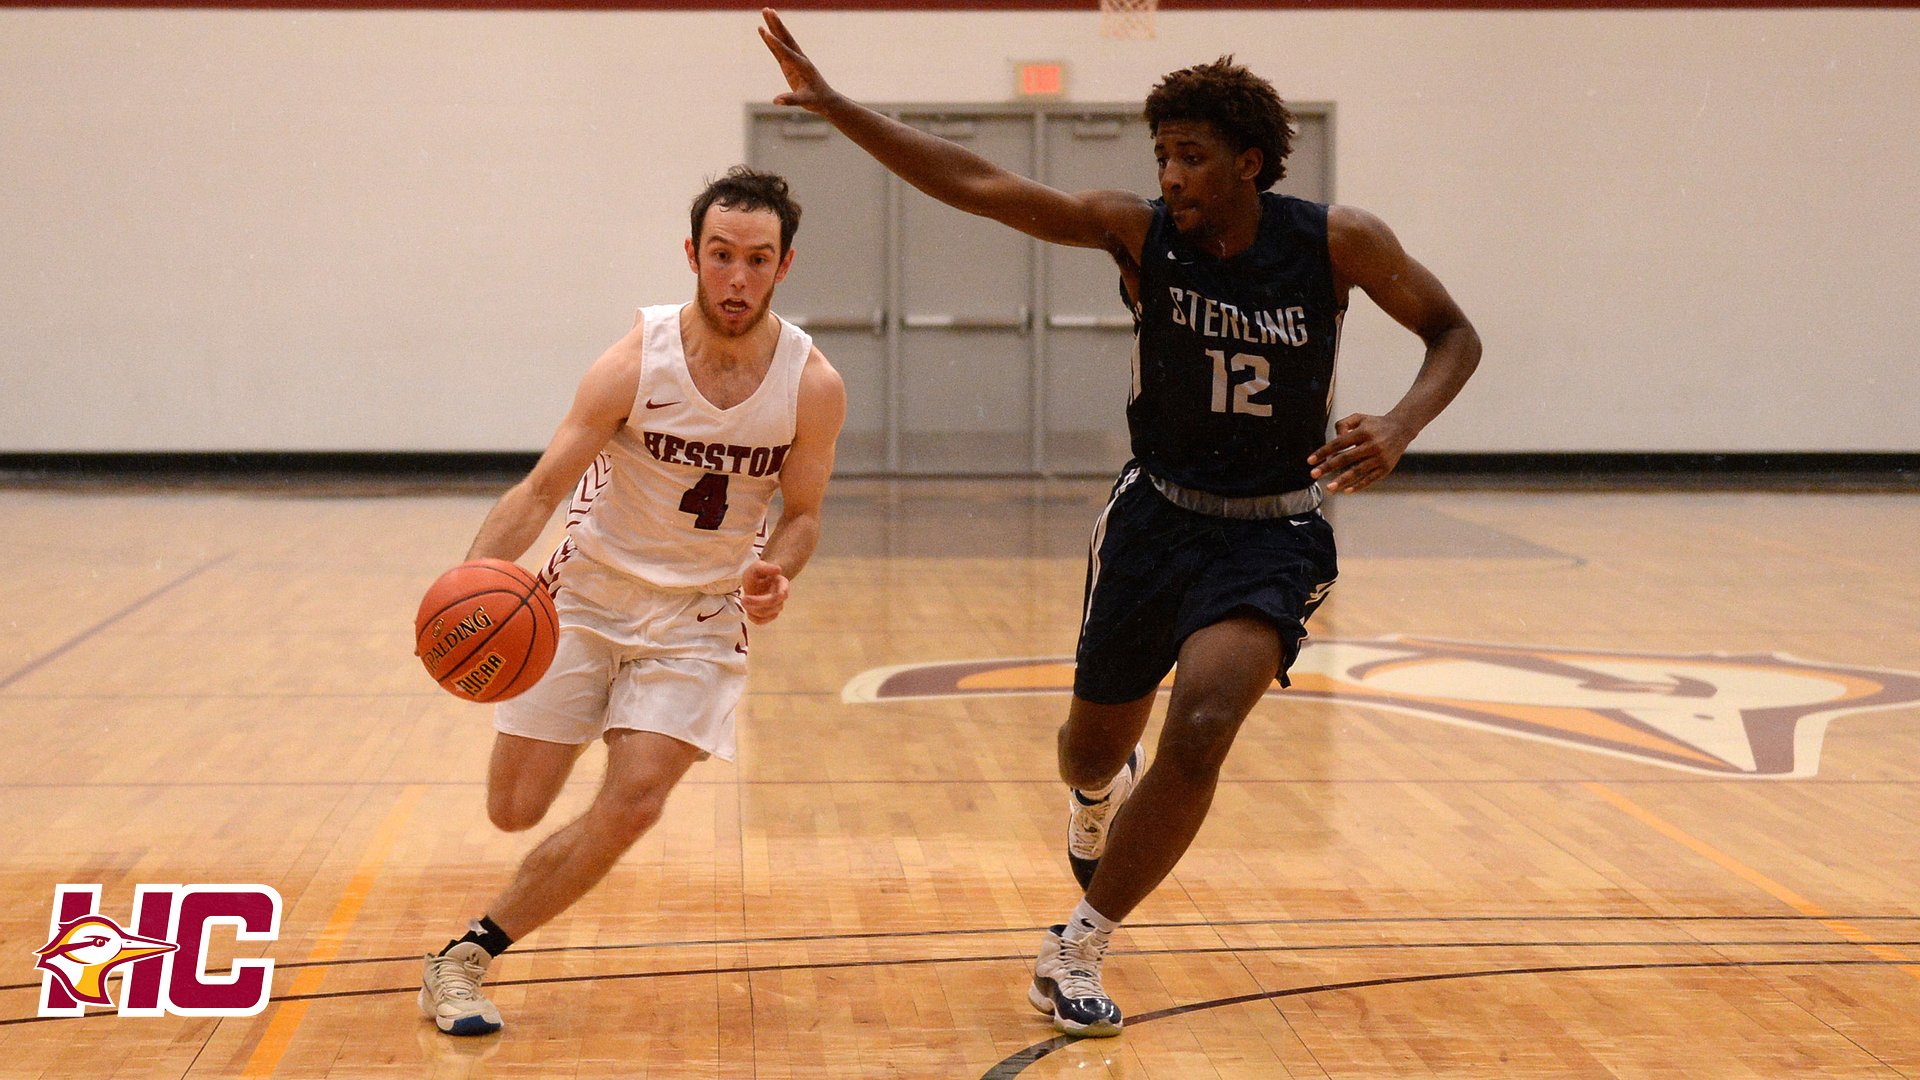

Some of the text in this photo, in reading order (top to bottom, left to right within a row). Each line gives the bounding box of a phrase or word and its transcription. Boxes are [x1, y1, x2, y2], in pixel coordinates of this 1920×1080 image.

[1169, 286, 1308, 347] STERLING
[1205, 348, 1273, 417] 12
[643, 431, 792, 478] HESSTON
[678, 472, 729, 531] 4
[421, 606, 493, 673] PALDING
